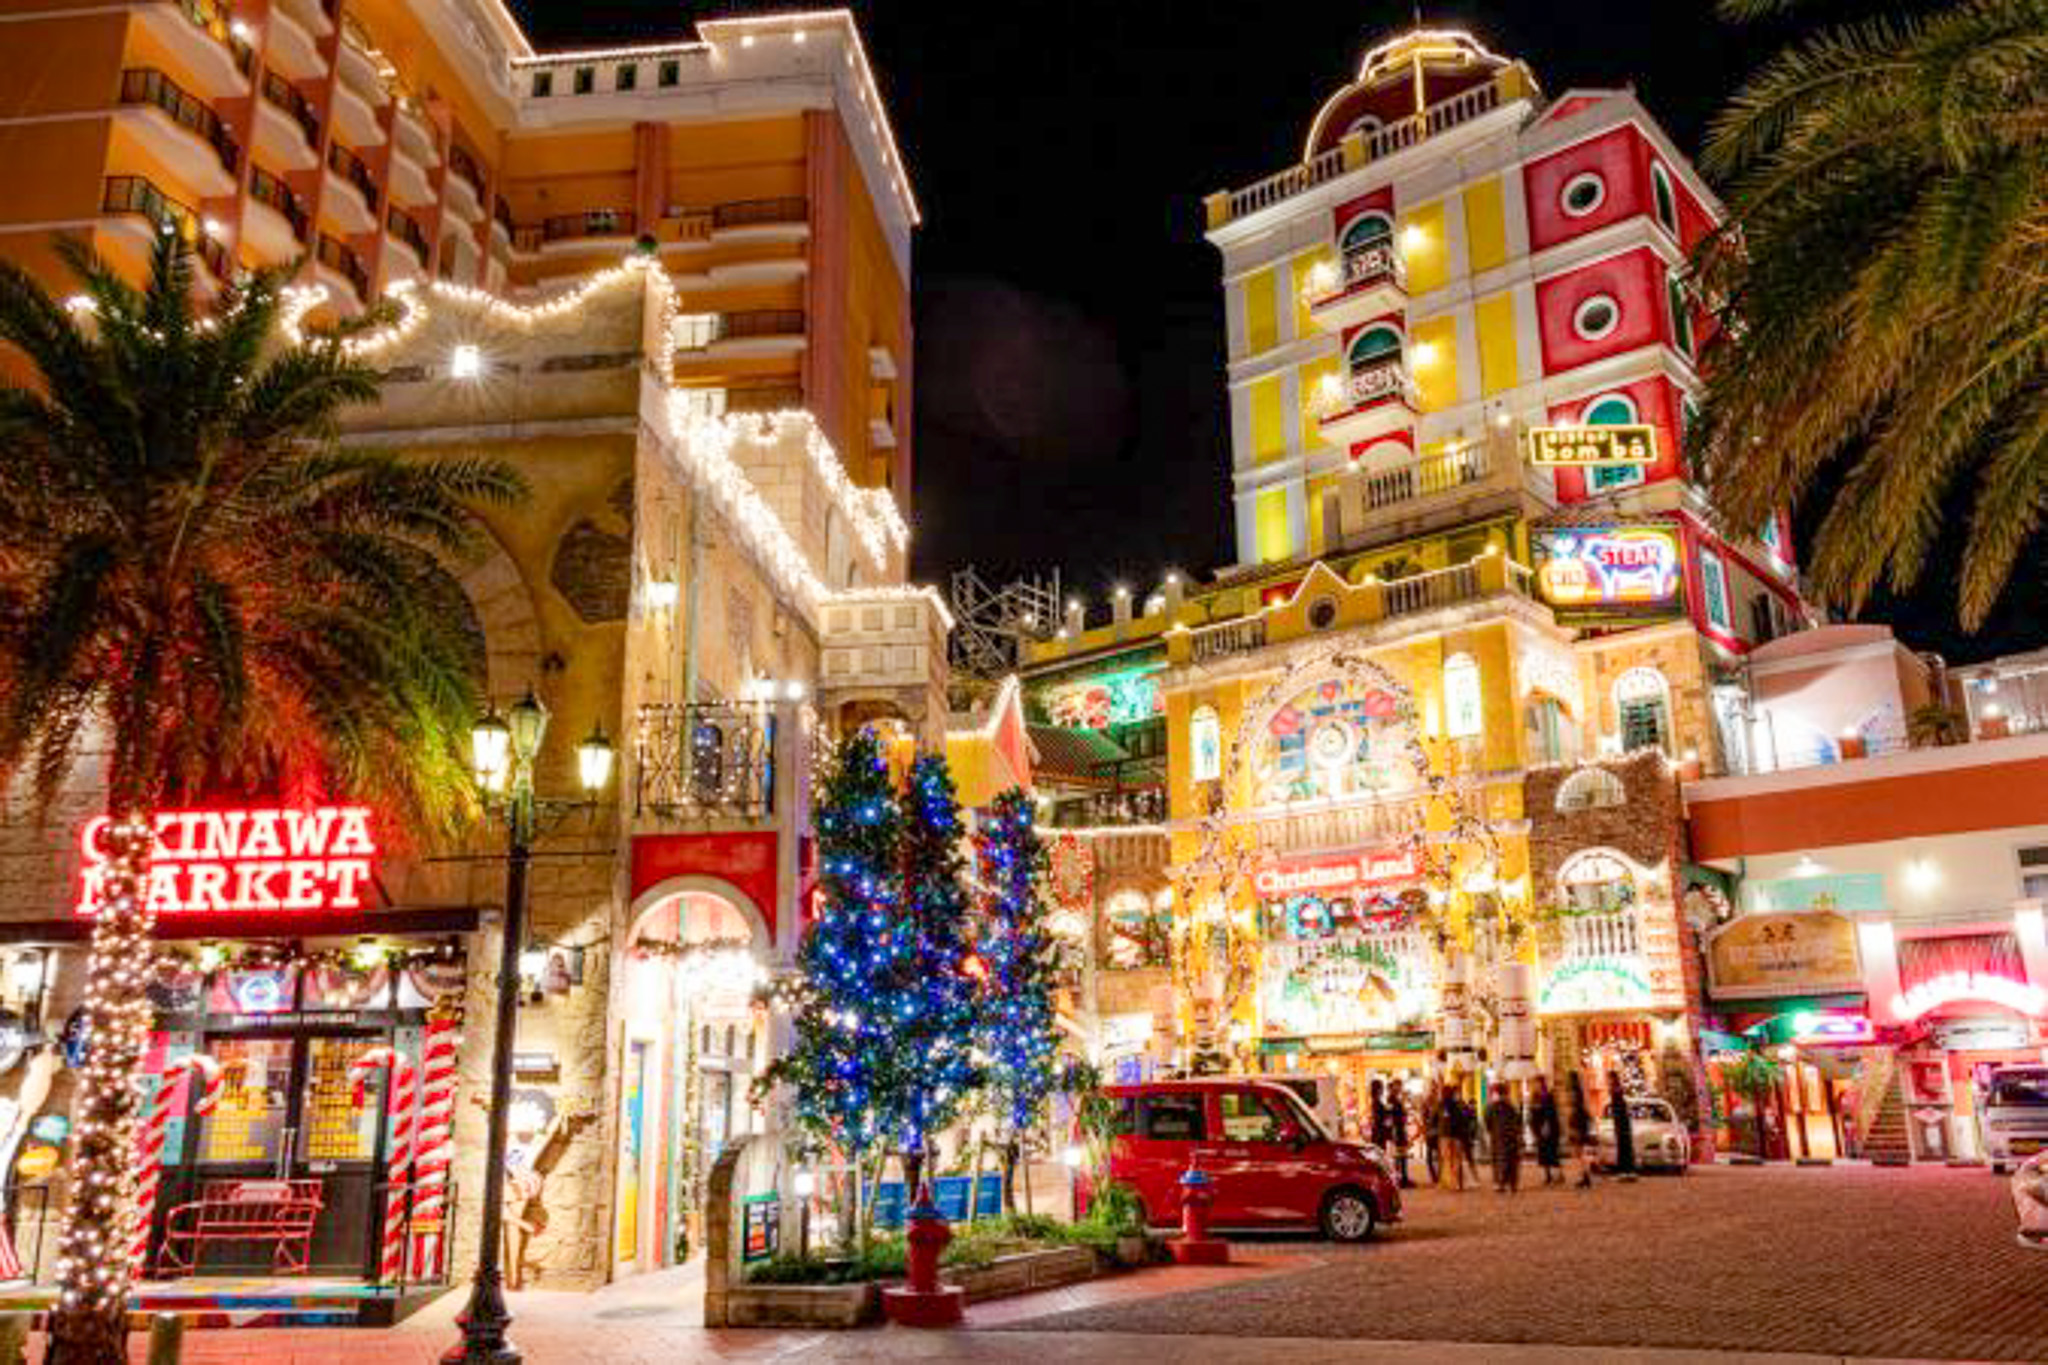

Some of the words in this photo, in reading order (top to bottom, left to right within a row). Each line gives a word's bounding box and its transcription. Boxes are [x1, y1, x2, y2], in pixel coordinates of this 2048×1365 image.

[1601, 545, 1658, 565] STEAK
[1256, 863, 1359, 892] Christmas
[1360, 852, 1415, 881] Land
